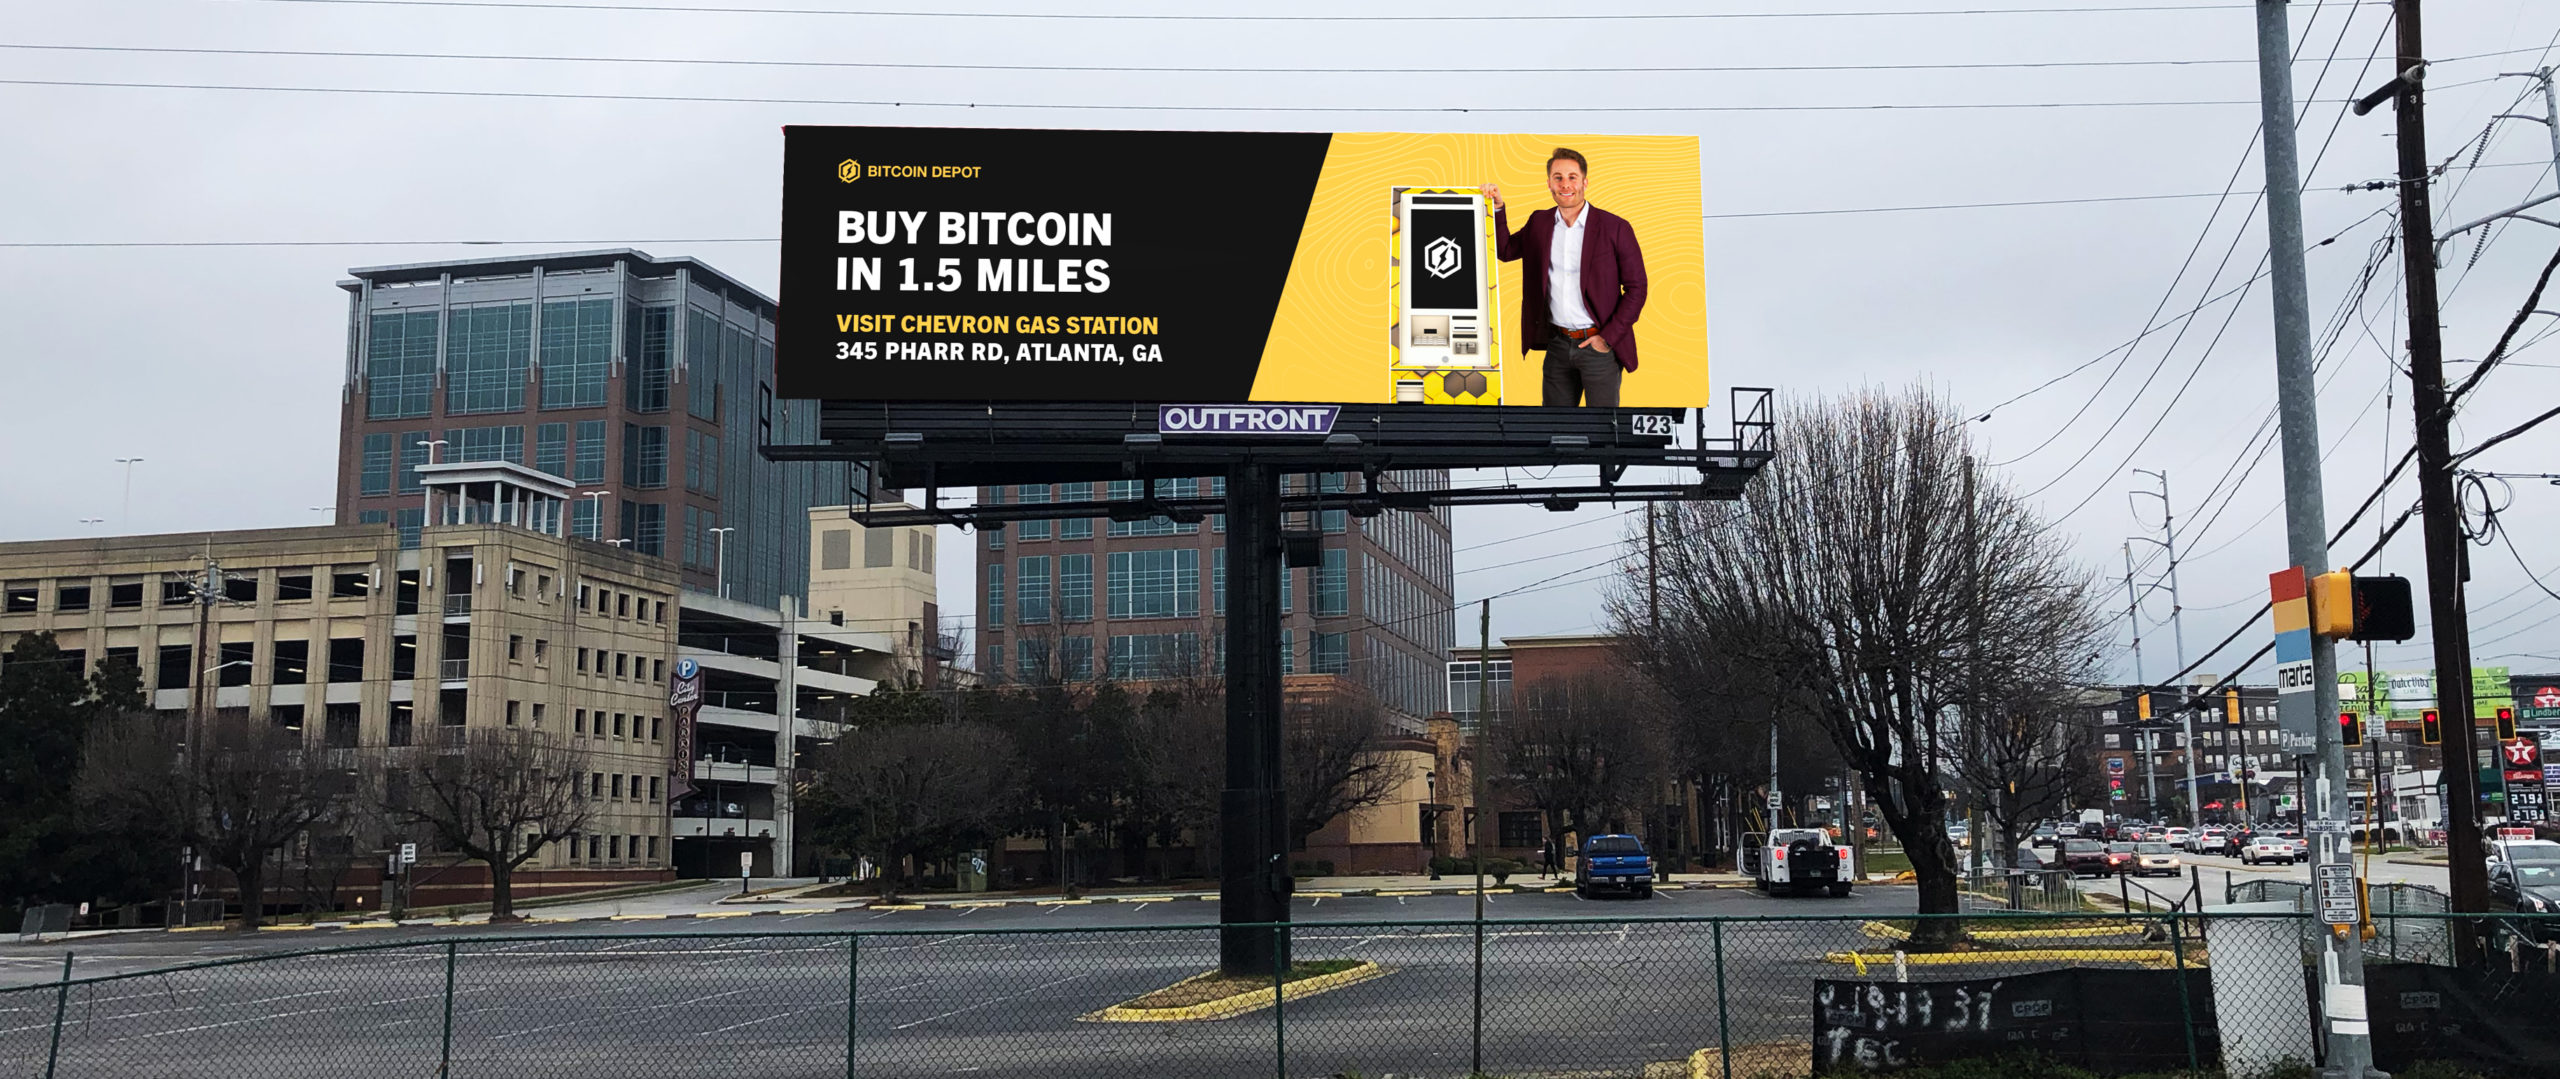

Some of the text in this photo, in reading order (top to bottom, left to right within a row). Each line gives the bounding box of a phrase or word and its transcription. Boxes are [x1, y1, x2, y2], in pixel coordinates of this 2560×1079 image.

[867, 165, 982, 179] BITCOIN DEPOT
[837, 210, 1112, 247] BUY BITCOIN
[836, 256, 1111, 294] IN 1.5 MILES
[836, 314, 1159, 335] VISIT CHEVRON GAS STATION
[835, 341, 1164, 366] 345 PHARR RD, ATLANTA, GA
[1164, 407, 1330, 430] OUTFRONT
[1633, 415, 1671, 435] 423
[681, 661, 692, 677] P
[2279, 663, 2314, 689] marta
[670, 692, 699, 706] Center
[676, 682, 695, 695] City
[678, 706, 689, 780] PARKING
[2290, 731, 2317, 751] Parking
